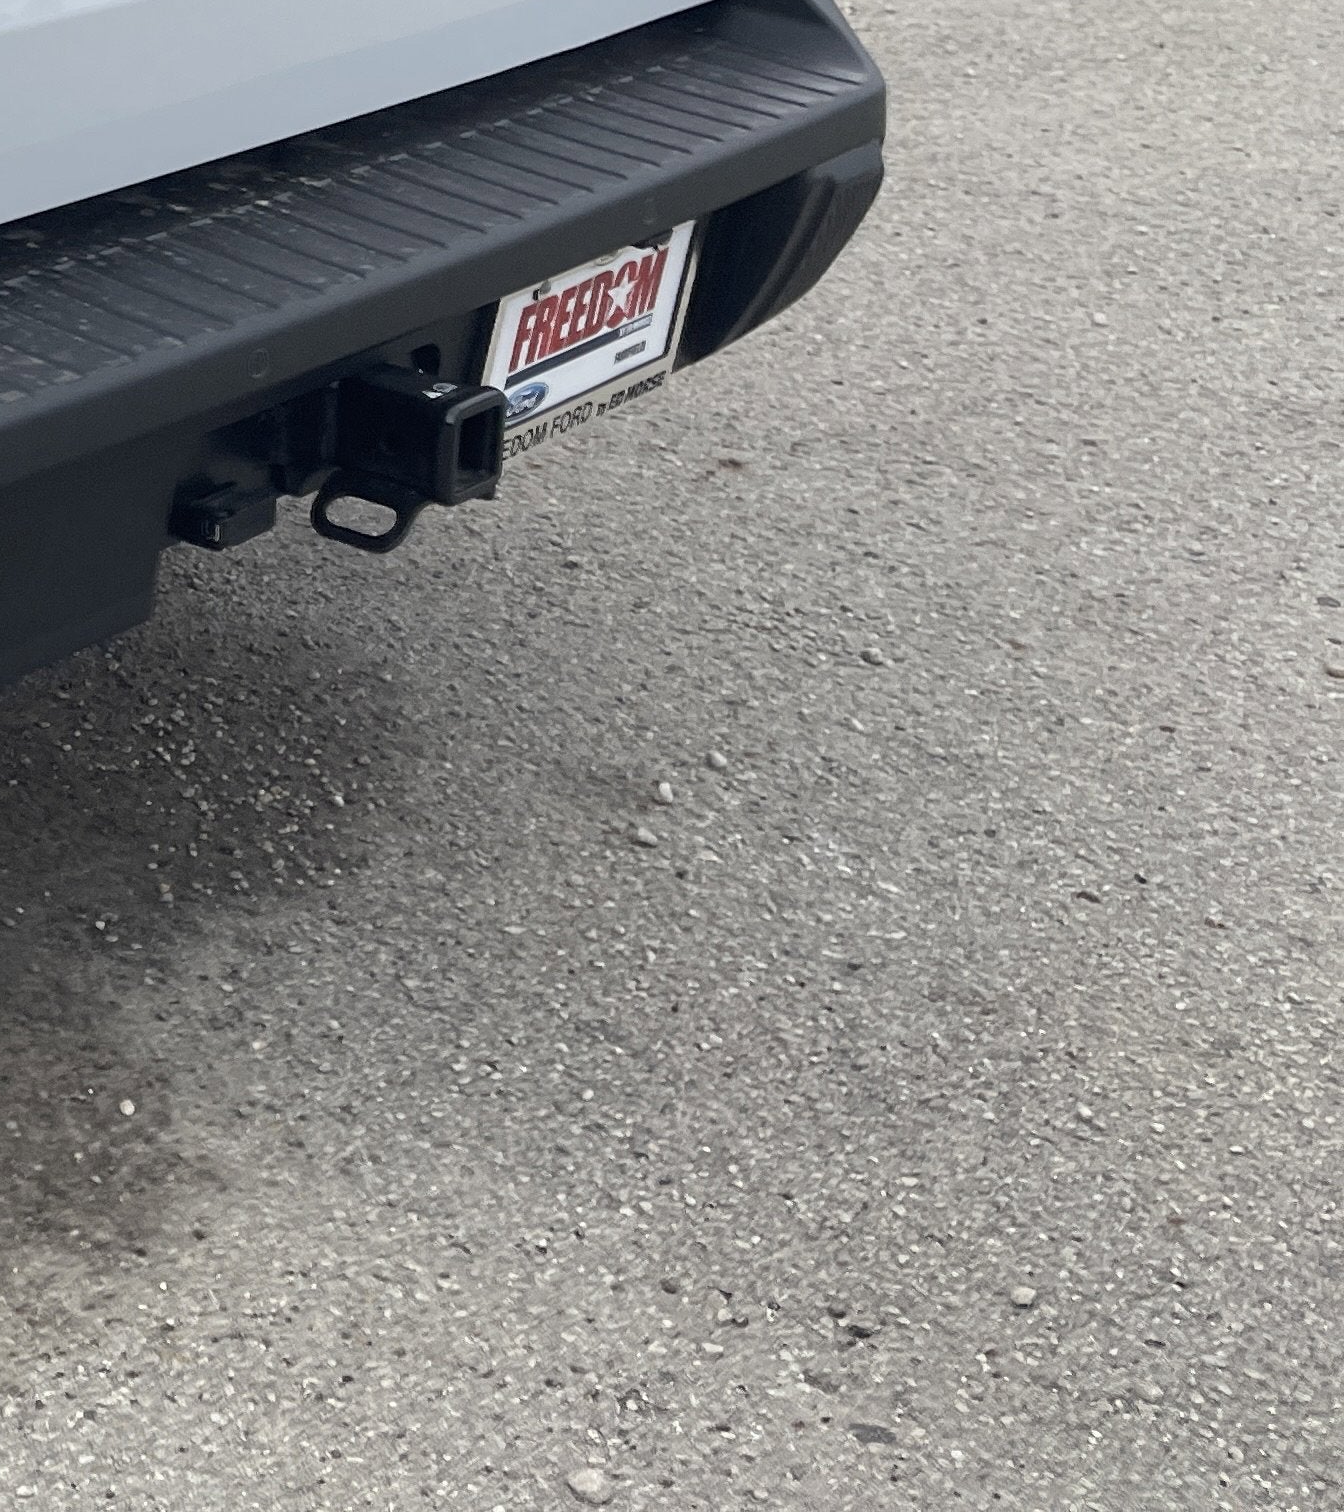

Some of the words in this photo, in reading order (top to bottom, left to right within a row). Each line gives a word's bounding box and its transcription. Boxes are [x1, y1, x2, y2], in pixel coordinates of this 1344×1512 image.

[507, 246, 669, 374] FREEDOM
[502, 422, 548, 461] EDOM
[551, 401, 593, 437] FORD
